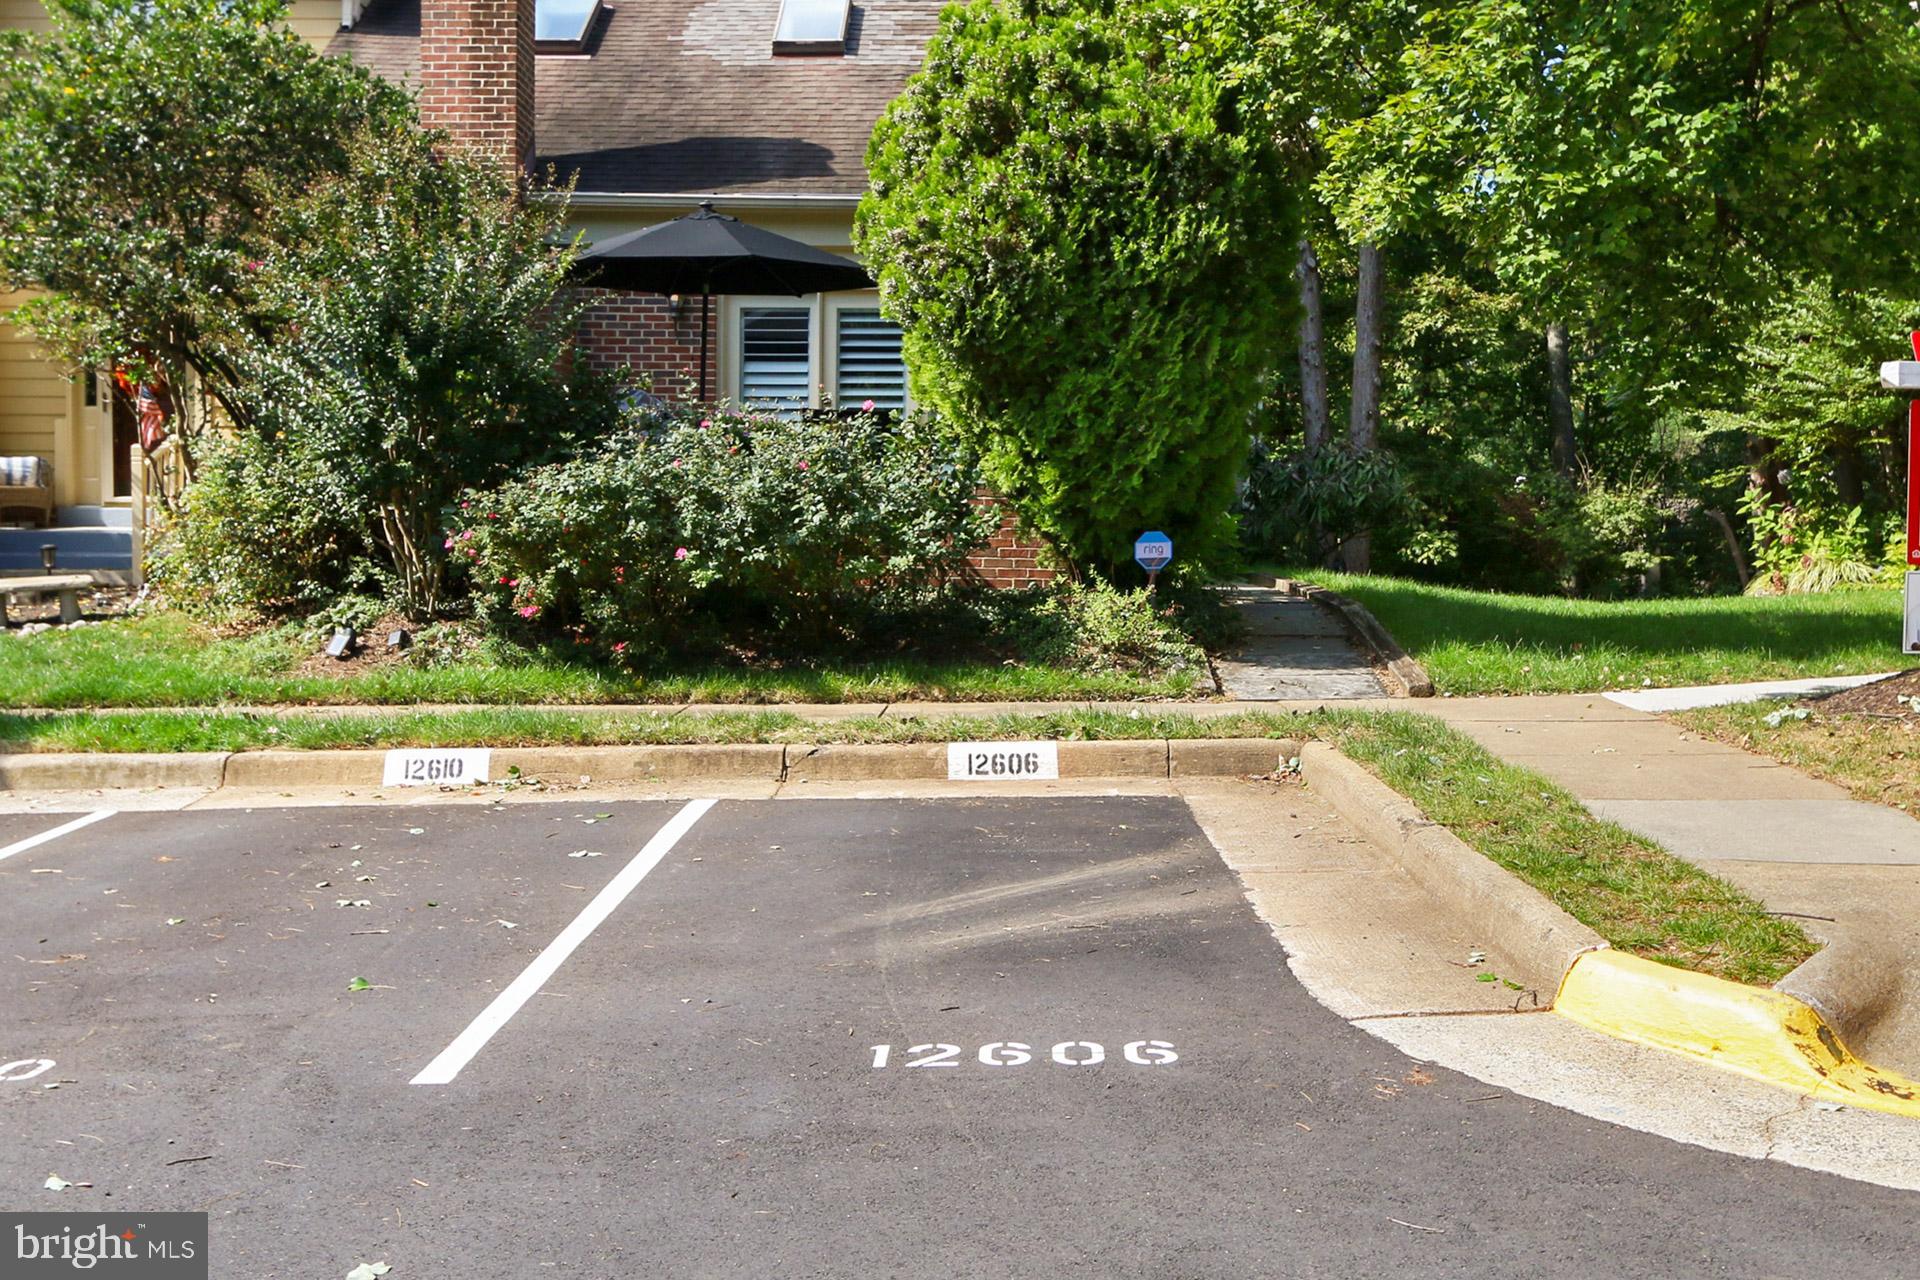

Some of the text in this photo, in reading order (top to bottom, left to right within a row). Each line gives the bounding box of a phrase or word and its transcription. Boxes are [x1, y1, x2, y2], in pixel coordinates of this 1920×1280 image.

[1143, 544, 1164, 556] ring
[404, 758, 463, 780] 12610
[968, 752, 1039, 775] 12606
[869, 1040, 1179, 1068] 12606
